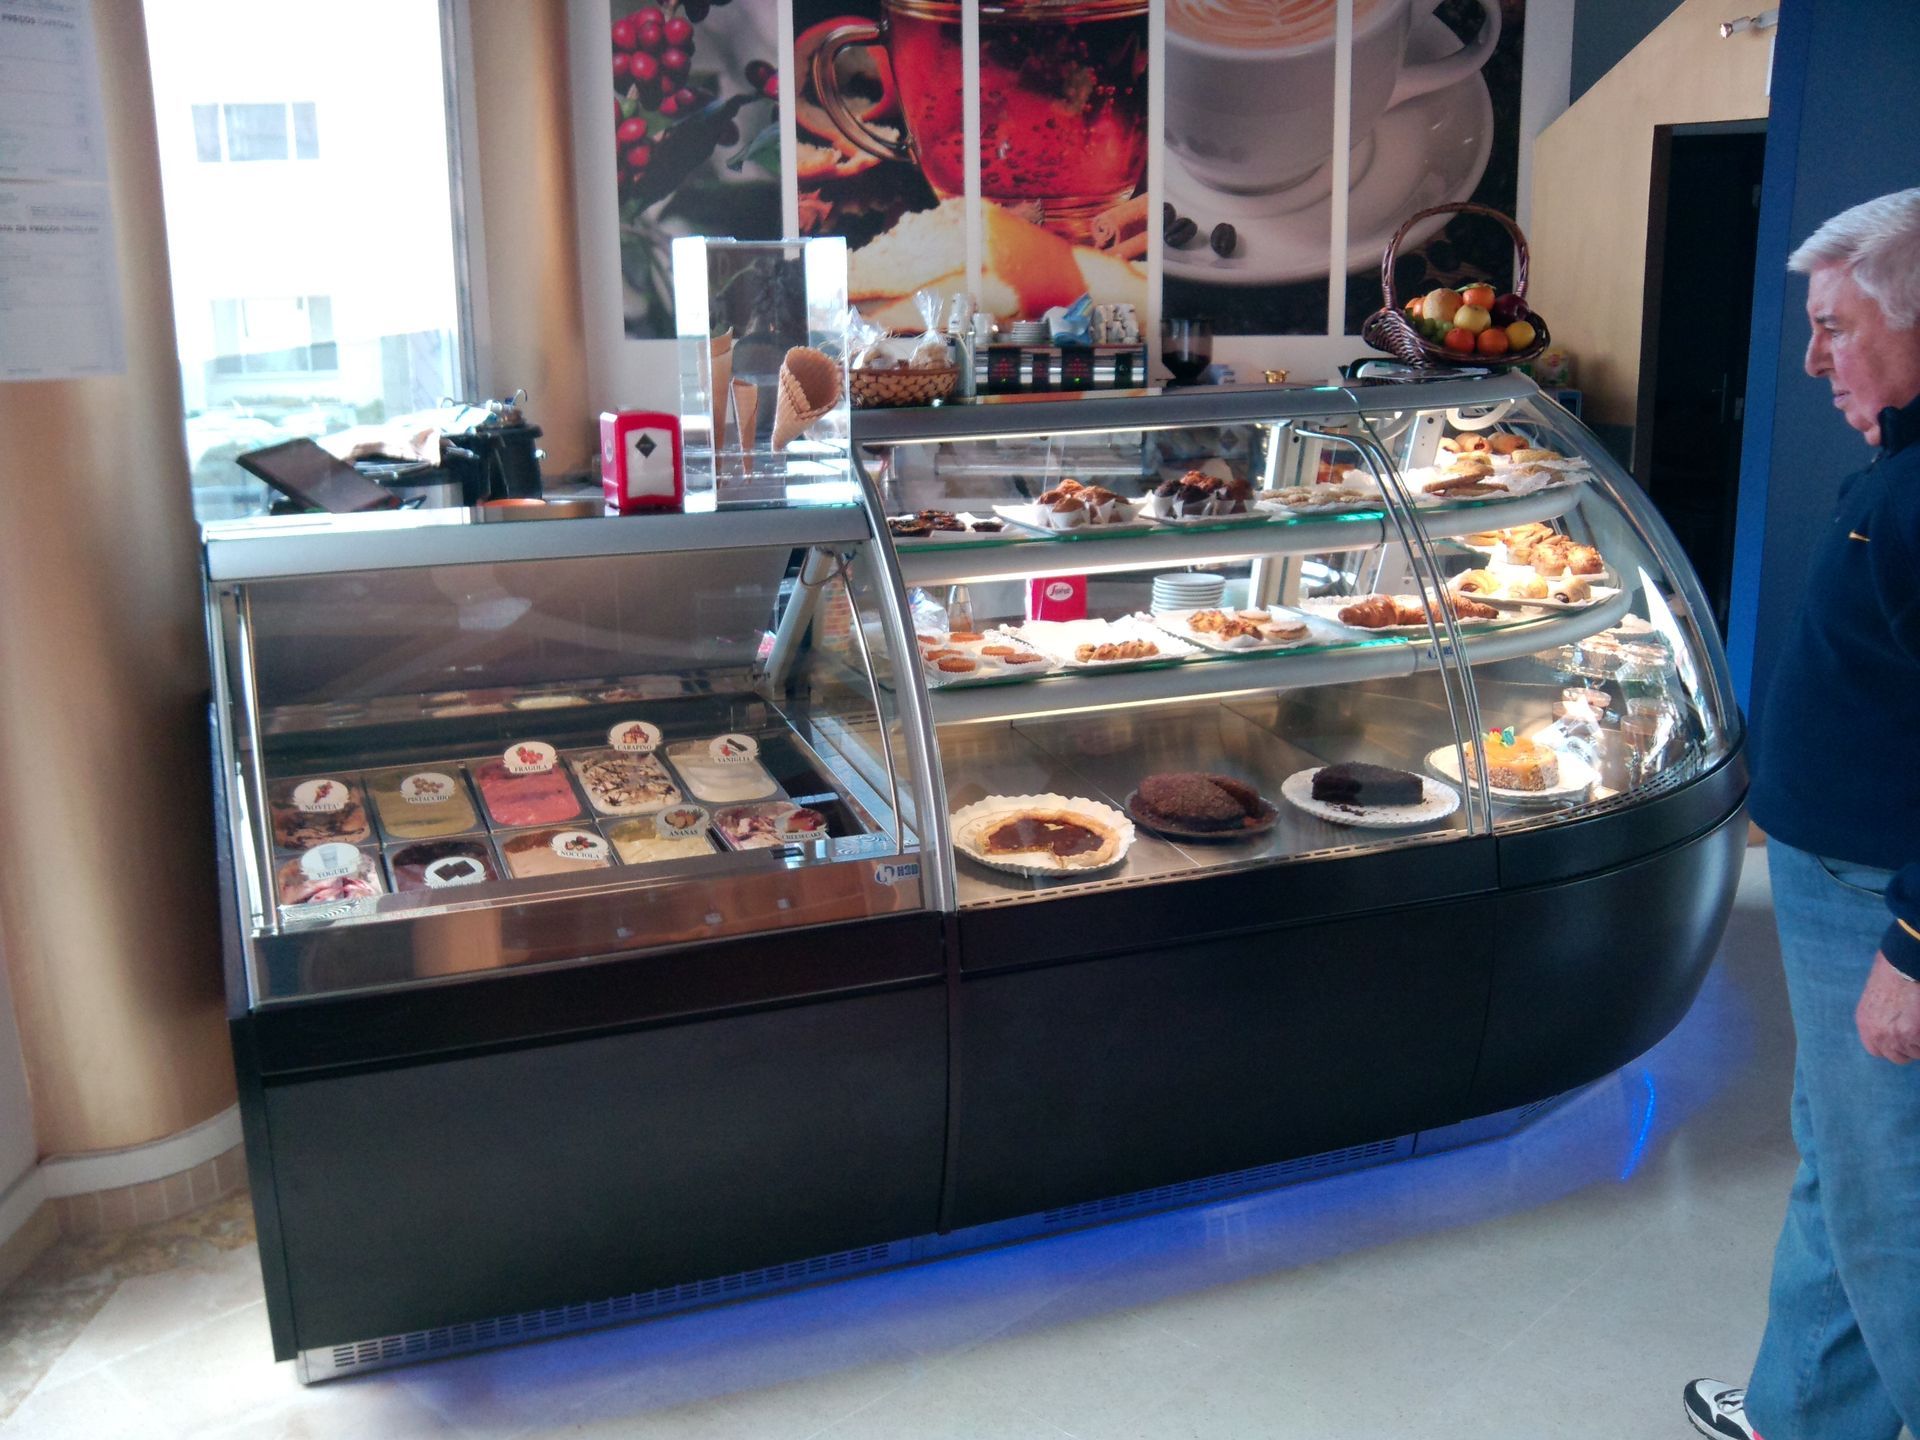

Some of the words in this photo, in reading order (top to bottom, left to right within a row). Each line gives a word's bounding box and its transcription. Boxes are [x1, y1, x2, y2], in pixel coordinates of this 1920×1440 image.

[514, 764, 548, 772] FRAGOLA
[407, 795, 450, 803] PISTACCHIO
[669, 829, 698, 837] ANANAS
[561, 850, 600, 859] NOCCIOLA
[317, 867, 349, 878] YOGURT
